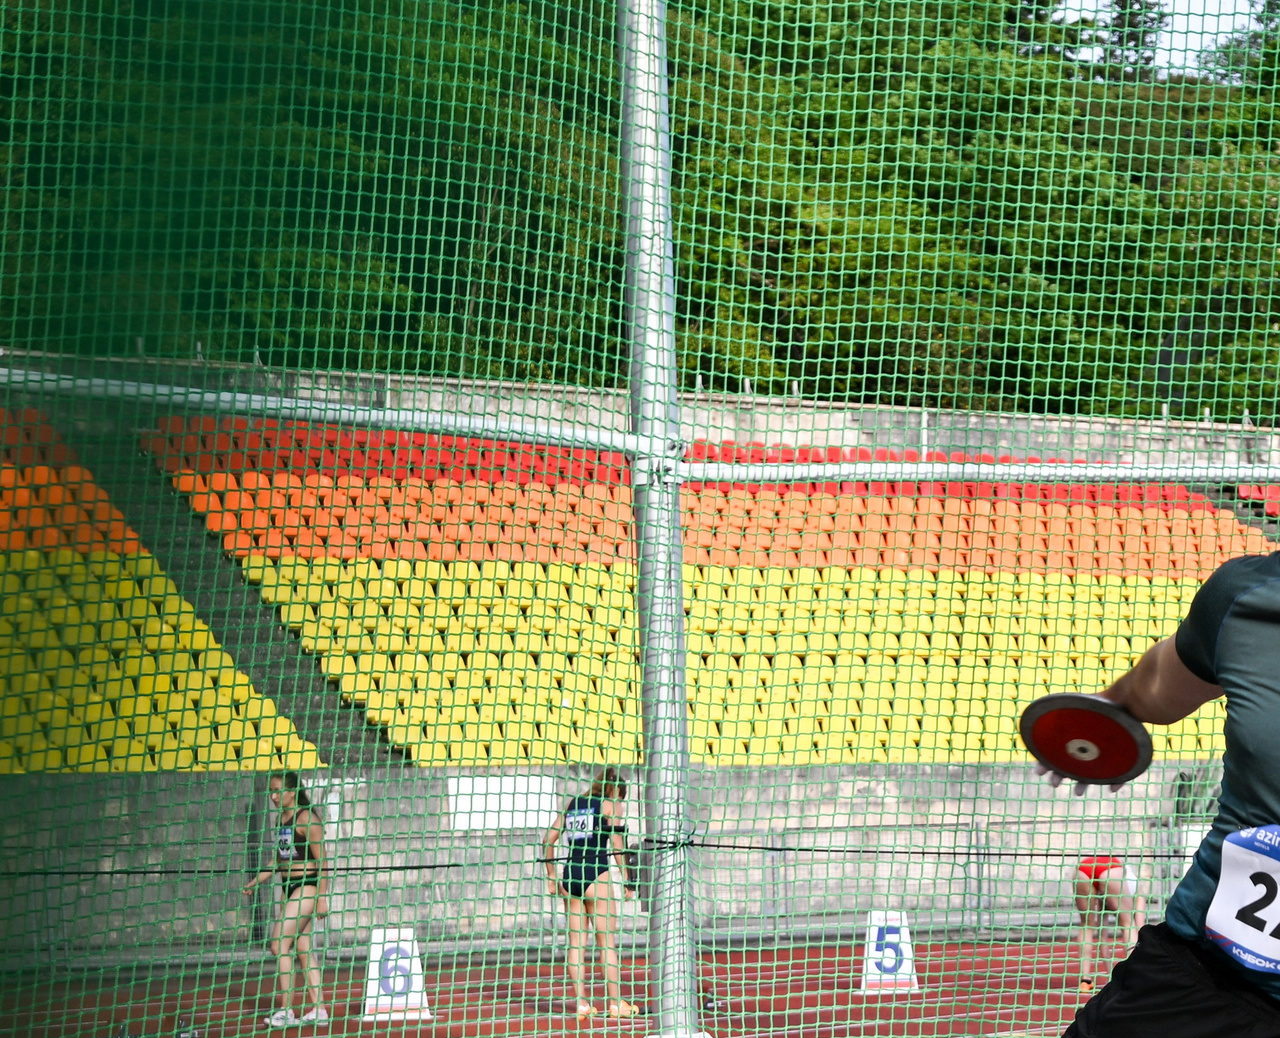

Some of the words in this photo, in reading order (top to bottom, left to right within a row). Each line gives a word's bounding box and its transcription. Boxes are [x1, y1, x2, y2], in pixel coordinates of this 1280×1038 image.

[378, 946, 414, 998] 6
[874, 926, 904, 974] 5
[1232, 946, 1277, 970] КУБОК
